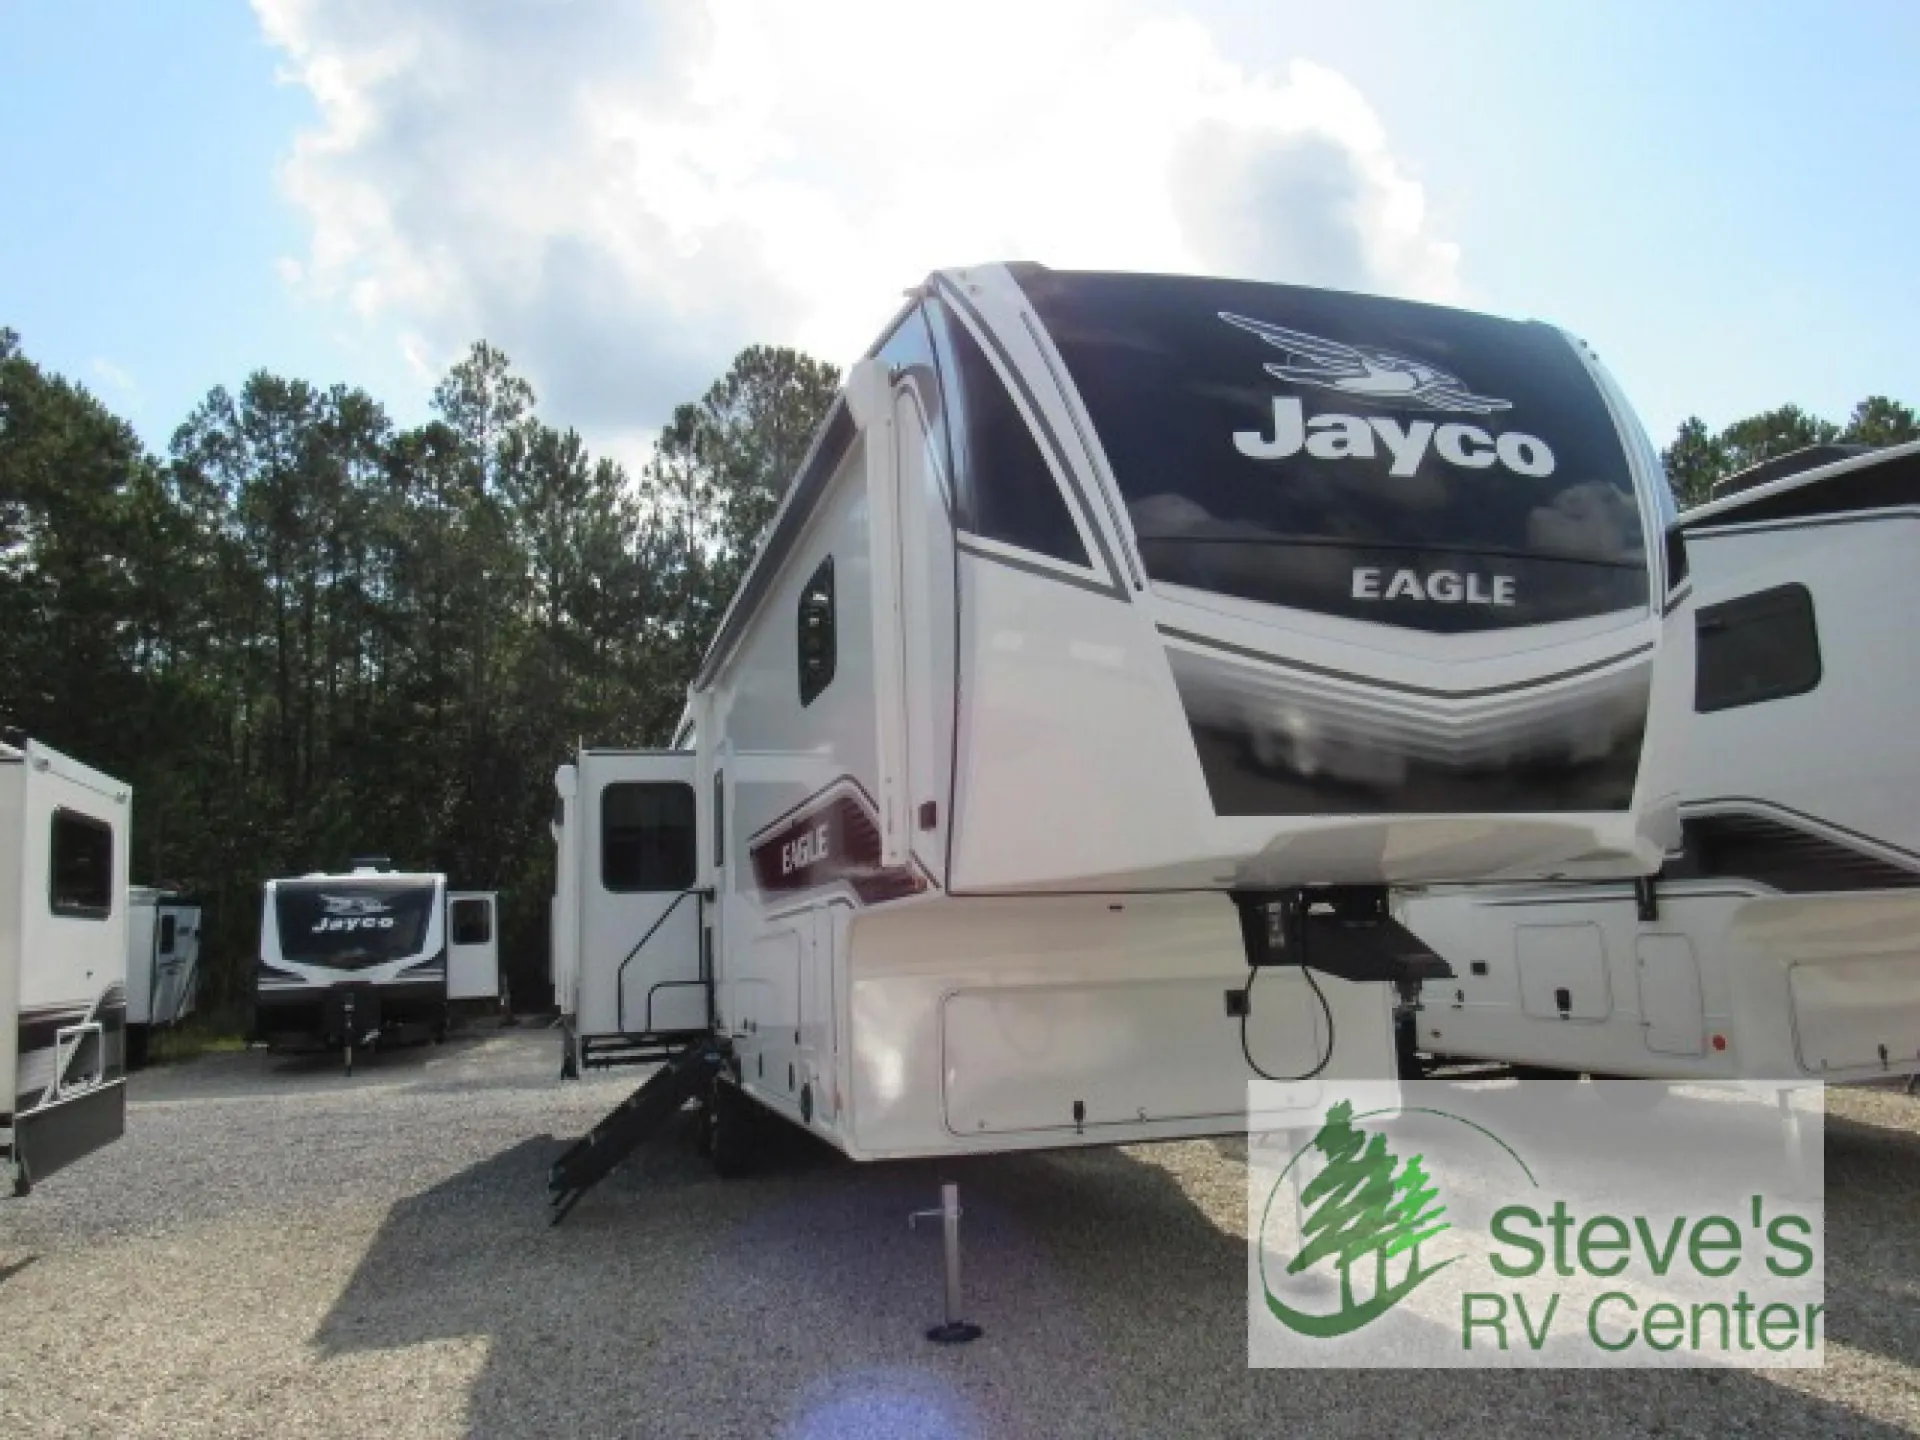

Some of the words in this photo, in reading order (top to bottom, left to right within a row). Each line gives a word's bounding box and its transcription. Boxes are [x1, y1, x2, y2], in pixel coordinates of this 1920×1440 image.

[1232, 395, 1557, 478] Jayco
[1351, 568, 1516, 605] EAGLE
[782, 823, 829, 875] EAGLE
[311, 916, 395, 933] Jayco
